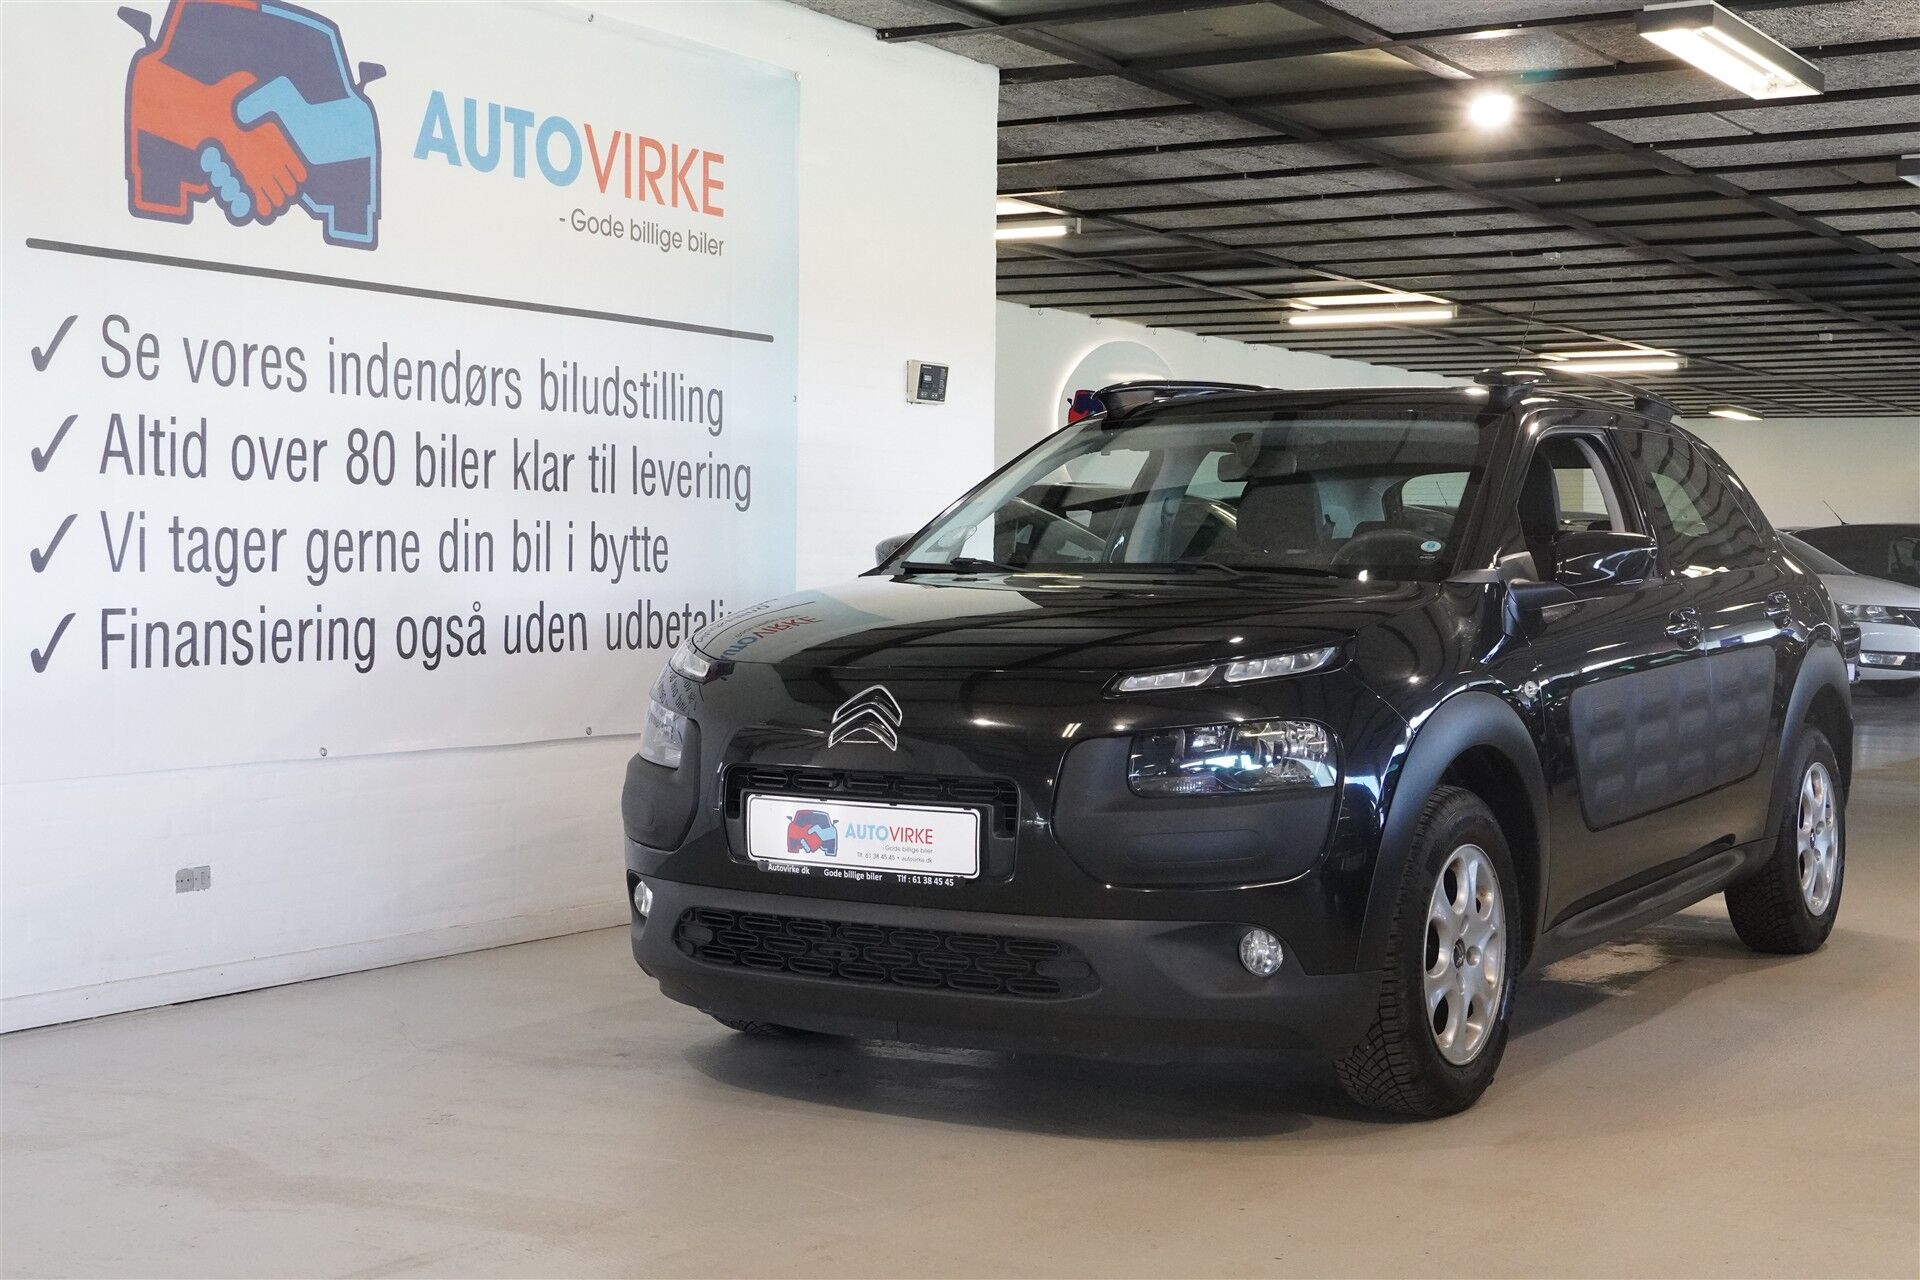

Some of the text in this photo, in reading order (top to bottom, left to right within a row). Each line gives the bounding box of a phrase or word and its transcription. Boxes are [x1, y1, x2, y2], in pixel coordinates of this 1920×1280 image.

[413, 89, 725, 218] AUTOVIRKE
[571, 208, 625, 239] Gode
[630, 218, 683, 253] billige
[688, 229, 725, 257] biler
[101, 314, 724, 437] Se vores indendørs biludstilling
[99, 413, 752, 513] Altid over 80 biler klar til levering
[100, 510, 670, 588] Vi tager gerne din bil i bytte
[101, 604, 377, 674] Finansiering
[395, 600, 488, 672] også
[503, 600, 589, 656] uden
[845, 823, 933, 844] AUTOVIRKE
[768, 863, 800, 874] Autovirke
[801, 866, 810, 875] dk
[823, 868, 843, 877] Gode
[843, 870, 865, 881] billige
[866, 871, 883, 881] biler
[897, 874, 907, 883] Tlf
[912, 875, 921, 885] 61
[923, 876, 933, 885] 38
[933, 877, 943, 886] 45
[944, 878, 954, 887] 45
